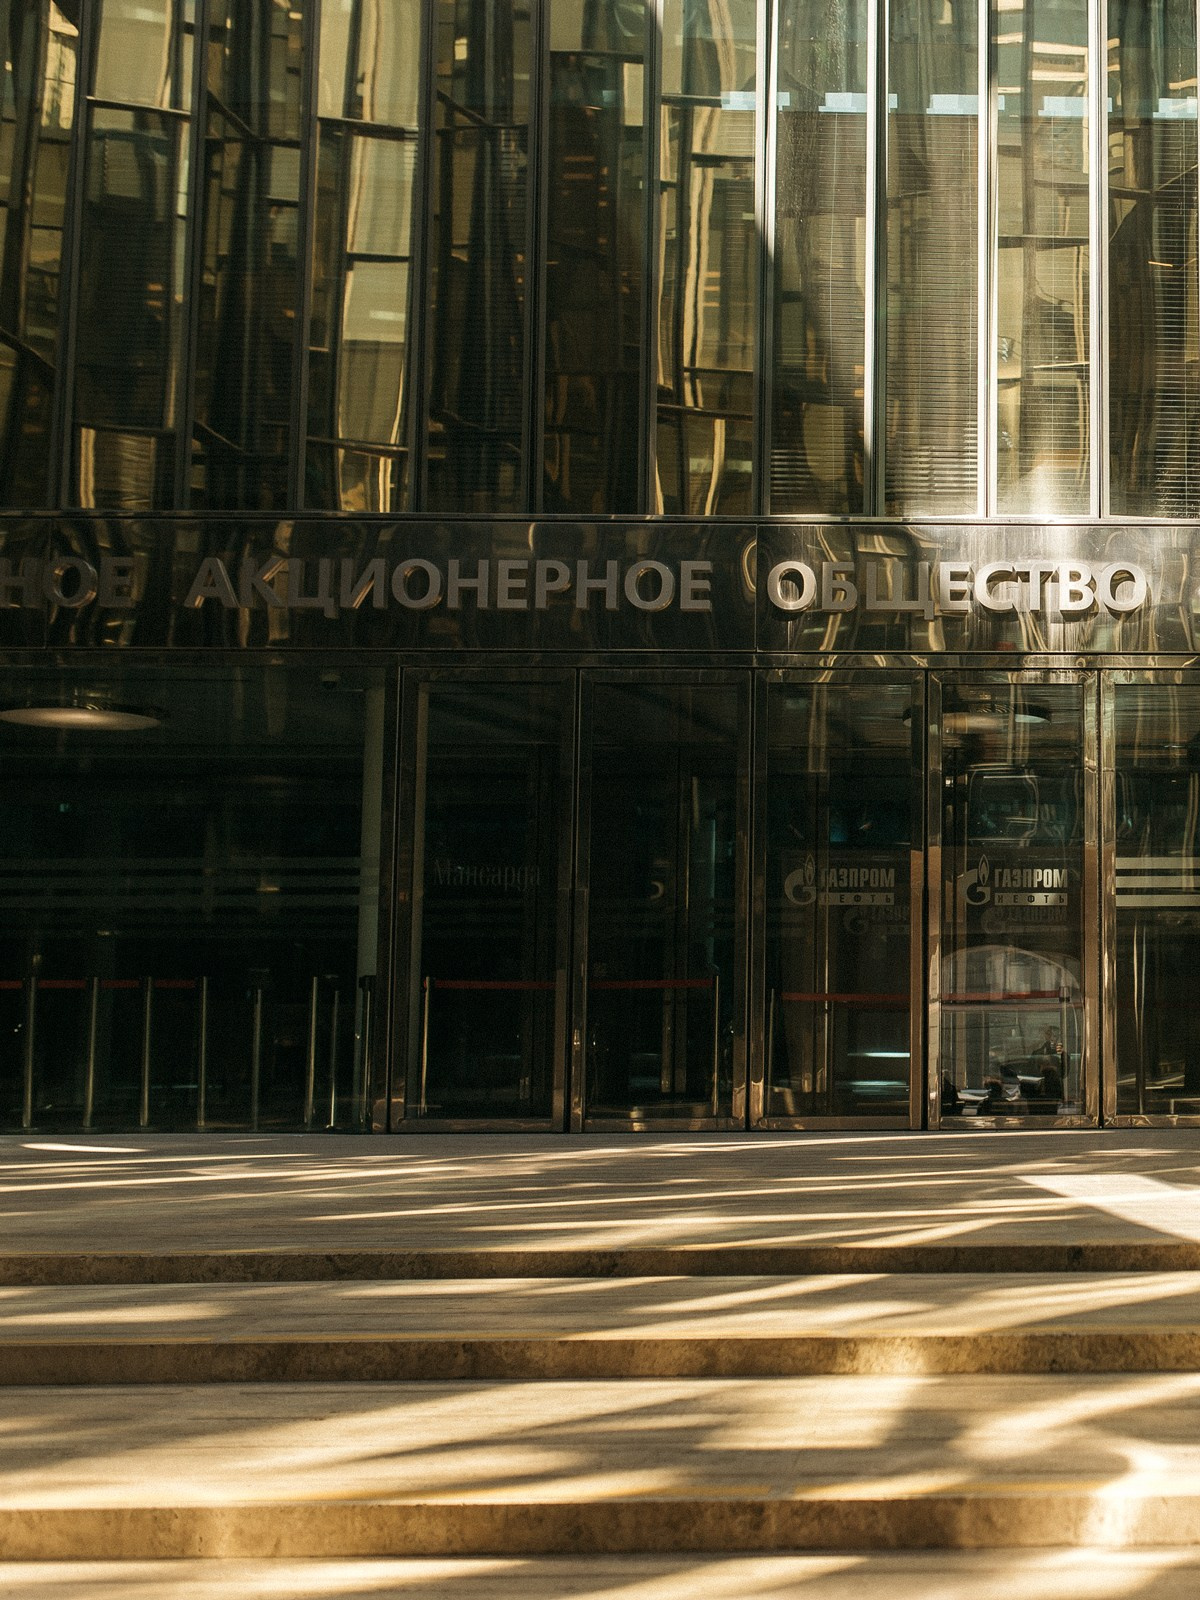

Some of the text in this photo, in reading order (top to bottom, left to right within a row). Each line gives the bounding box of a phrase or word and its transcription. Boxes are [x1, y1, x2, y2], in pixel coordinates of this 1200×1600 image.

[185, 559, 713, 619] АКЦИОНЕРНОЕ
[766, 561, 1146, 620] ОБЩЕСТВО
[820, 868, 895, 888] ГАЗПРОМ
[994, 868, 1068, 888] ГАЗПРОМ
[996, 894, 1066, 904] НЕФТЬ
